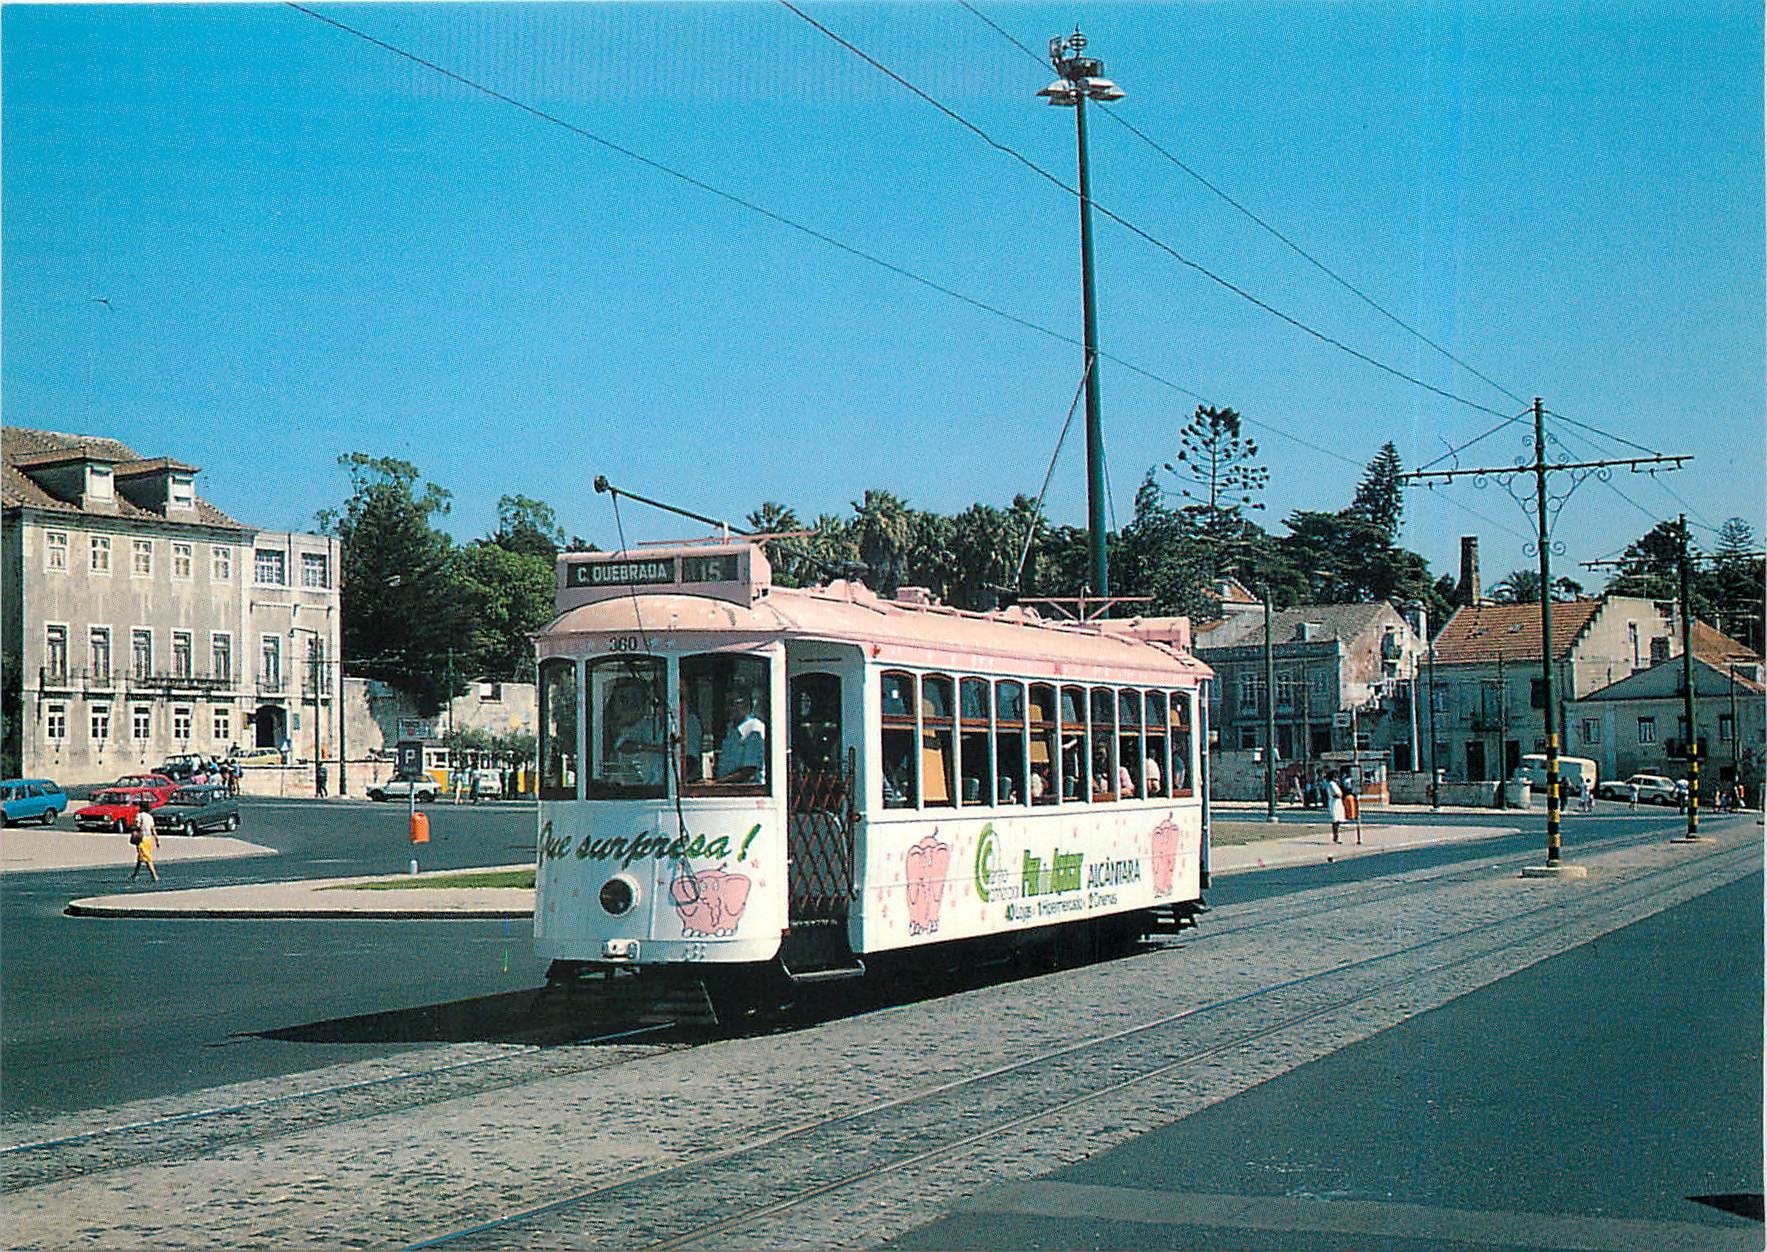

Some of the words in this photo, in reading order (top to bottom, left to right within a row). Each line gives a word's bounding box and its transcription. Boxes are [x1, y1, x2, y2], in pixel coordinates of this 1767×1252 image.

[577, 566, 589, 583] C.
[593, 562, 668, 583] QUEBRADA
[701, 561, 721, 582] 15
[609, 636, 638, 652] 360
